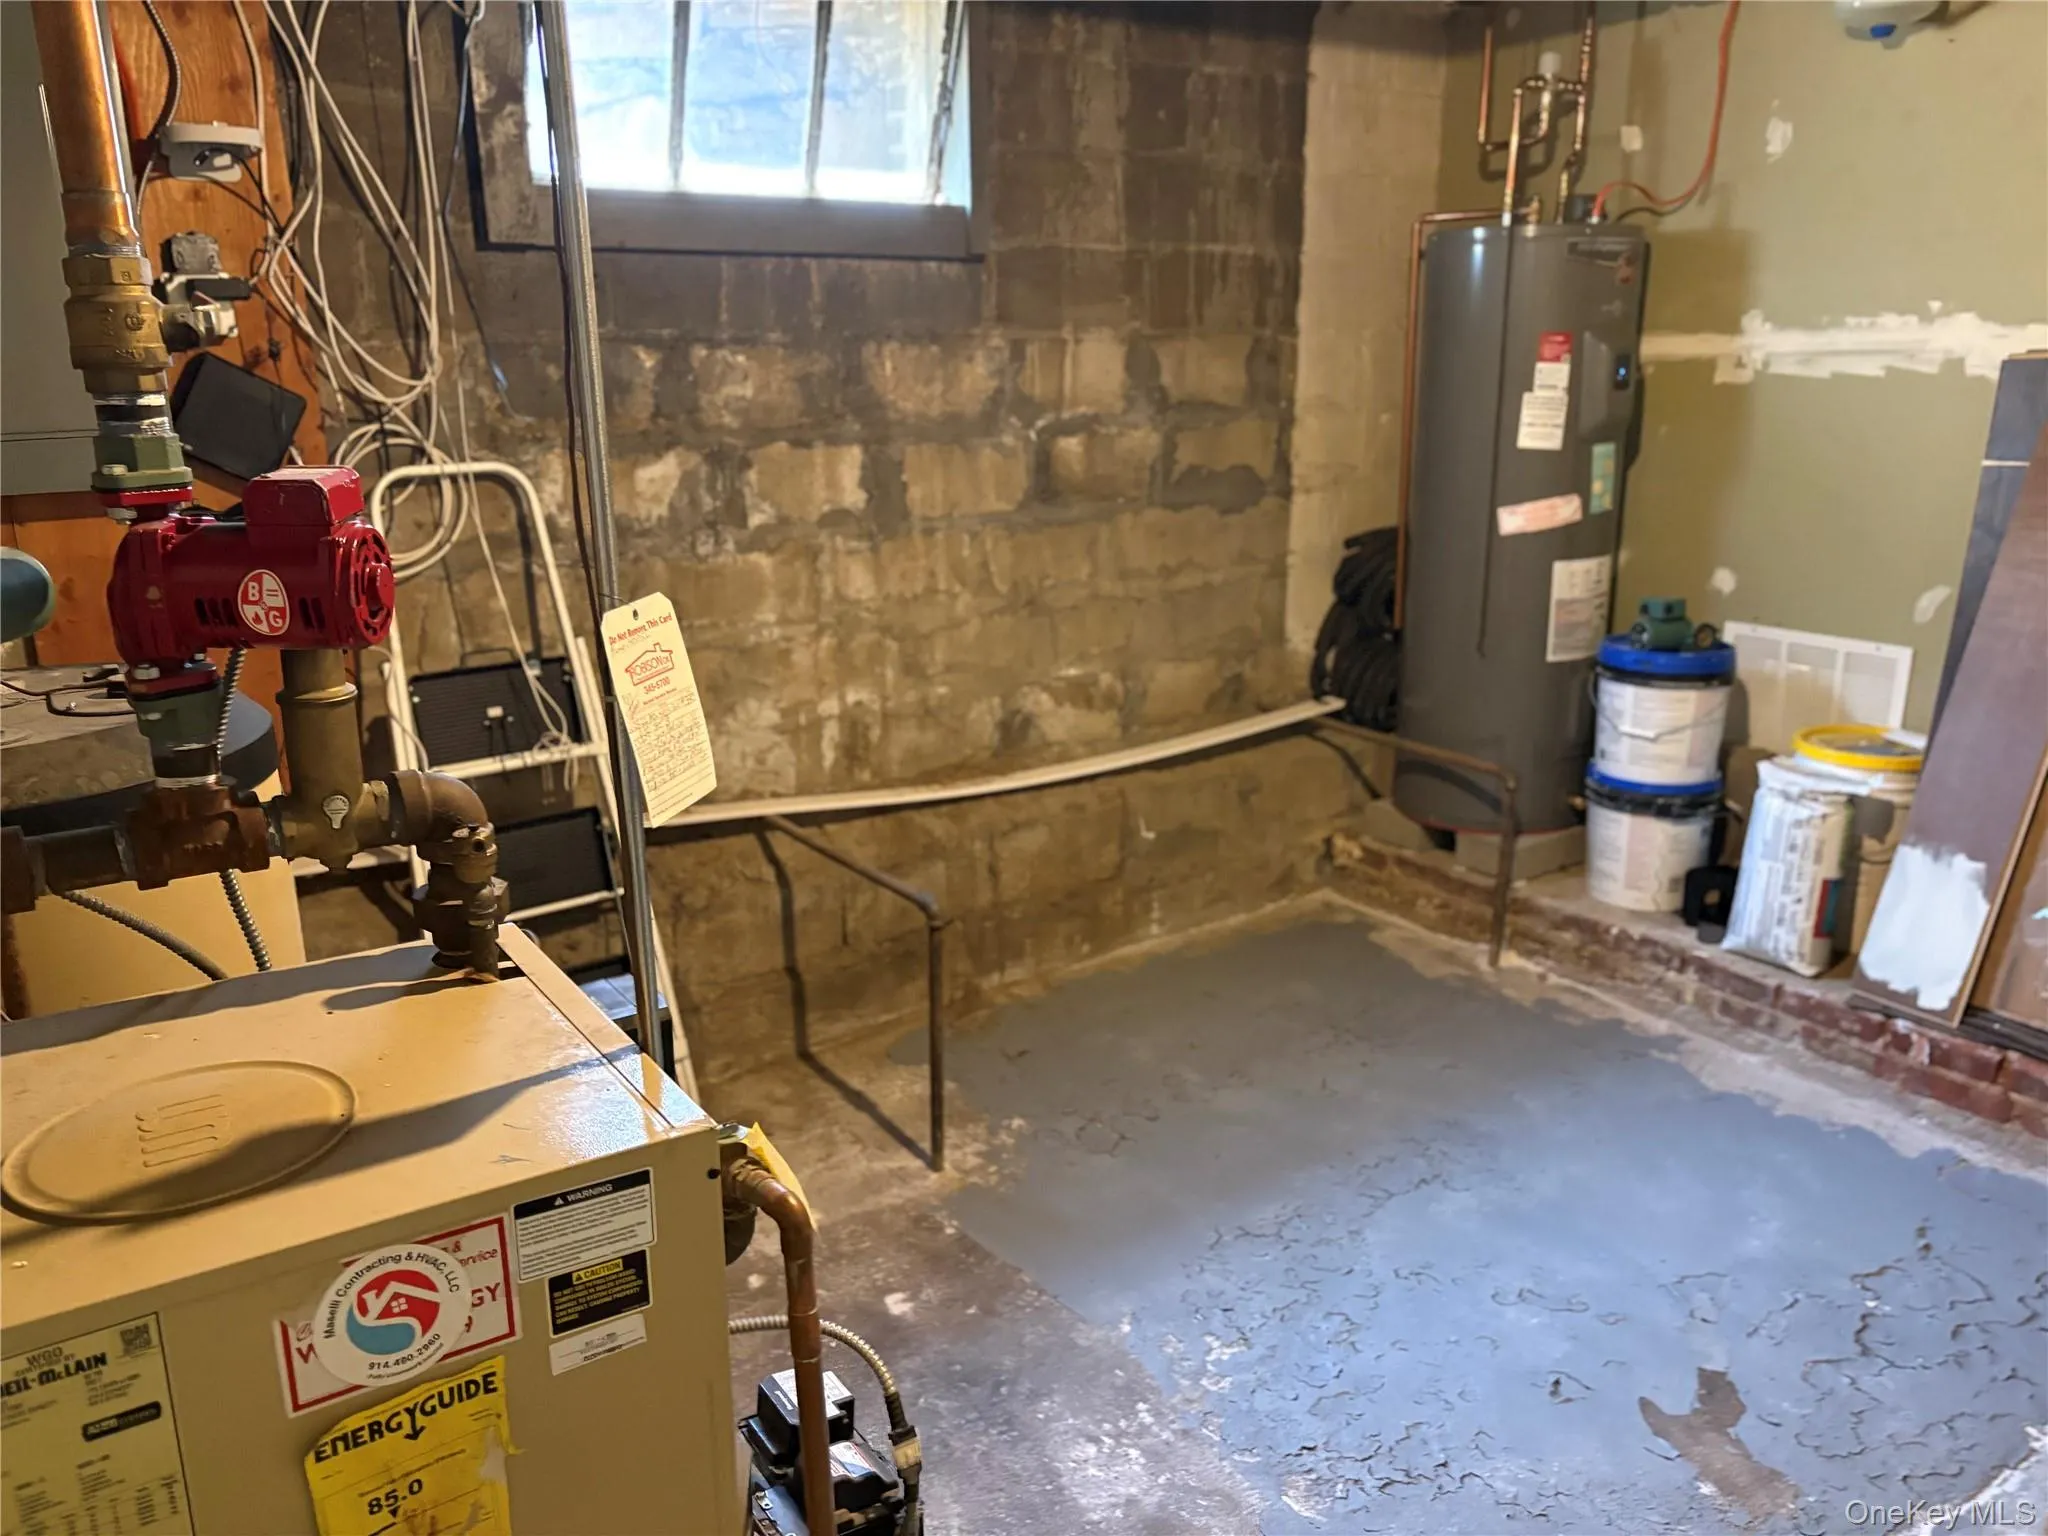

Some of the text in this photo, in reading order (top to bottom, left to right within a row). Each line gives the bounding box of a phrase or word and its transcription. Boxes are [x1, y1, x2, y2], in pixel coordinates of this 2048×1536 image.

[248, 581, 260, 601] B
[269, 610, 283, 628] G
[608, 636, 617, 646] Do
[617, 631, 627, 641] Not
[627, 624, 647, 636] Remove
[646, 618, 659, 629] This
[659, 612, 673, 624] Card
[566, 1183, 613, 1202] WARNING
[336, 1254, 402, 1297] Contracting
[404, 1251, 414, 1261] &
[445, 1270, 460, 1293] LLC
[460, 1248, 498, 1267] ervice
[583, 1260, 622, 1279] CAUTION
[368, 1478, 423, 1515] 85.0
